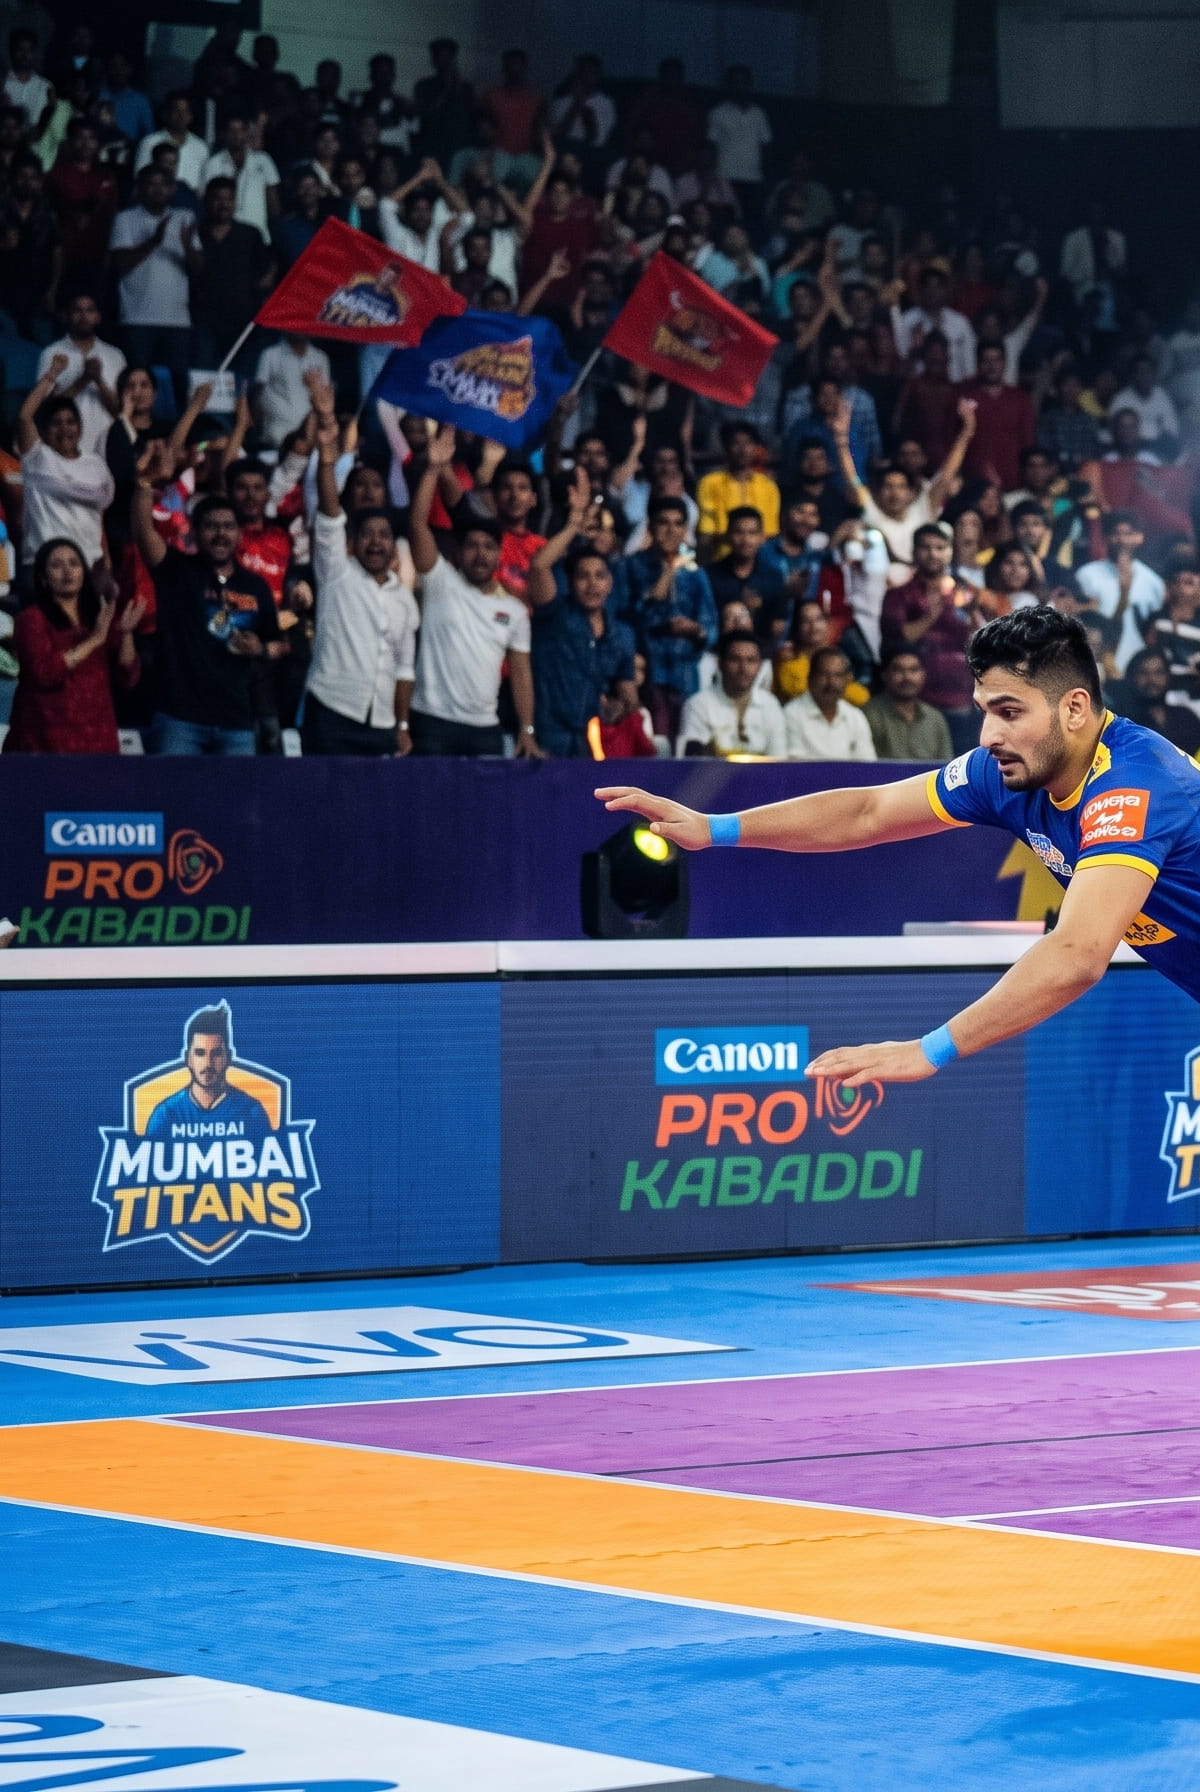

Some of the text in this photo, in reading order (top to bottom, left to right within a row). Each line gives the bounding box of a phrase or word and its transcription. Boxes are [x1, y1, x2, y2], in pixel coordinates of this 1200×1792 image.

[51, 819, 156, 847] Canon
[44, 860, 164, 900] PRO
[17, 905, 252, 944] KABADDI
[663, 1038, 799, 1074] Canon
[171, 1121, 244, 1138] MUMBAI
[655, 1090, 808, 1148] PRO
[106, 1132, 307, 1187] MUMBAI
[619, 1149, 923, 1211] KABADDI
[113, 1181, 302, 1237] TITANS
[0, 1331, 630, 1370] vivo
